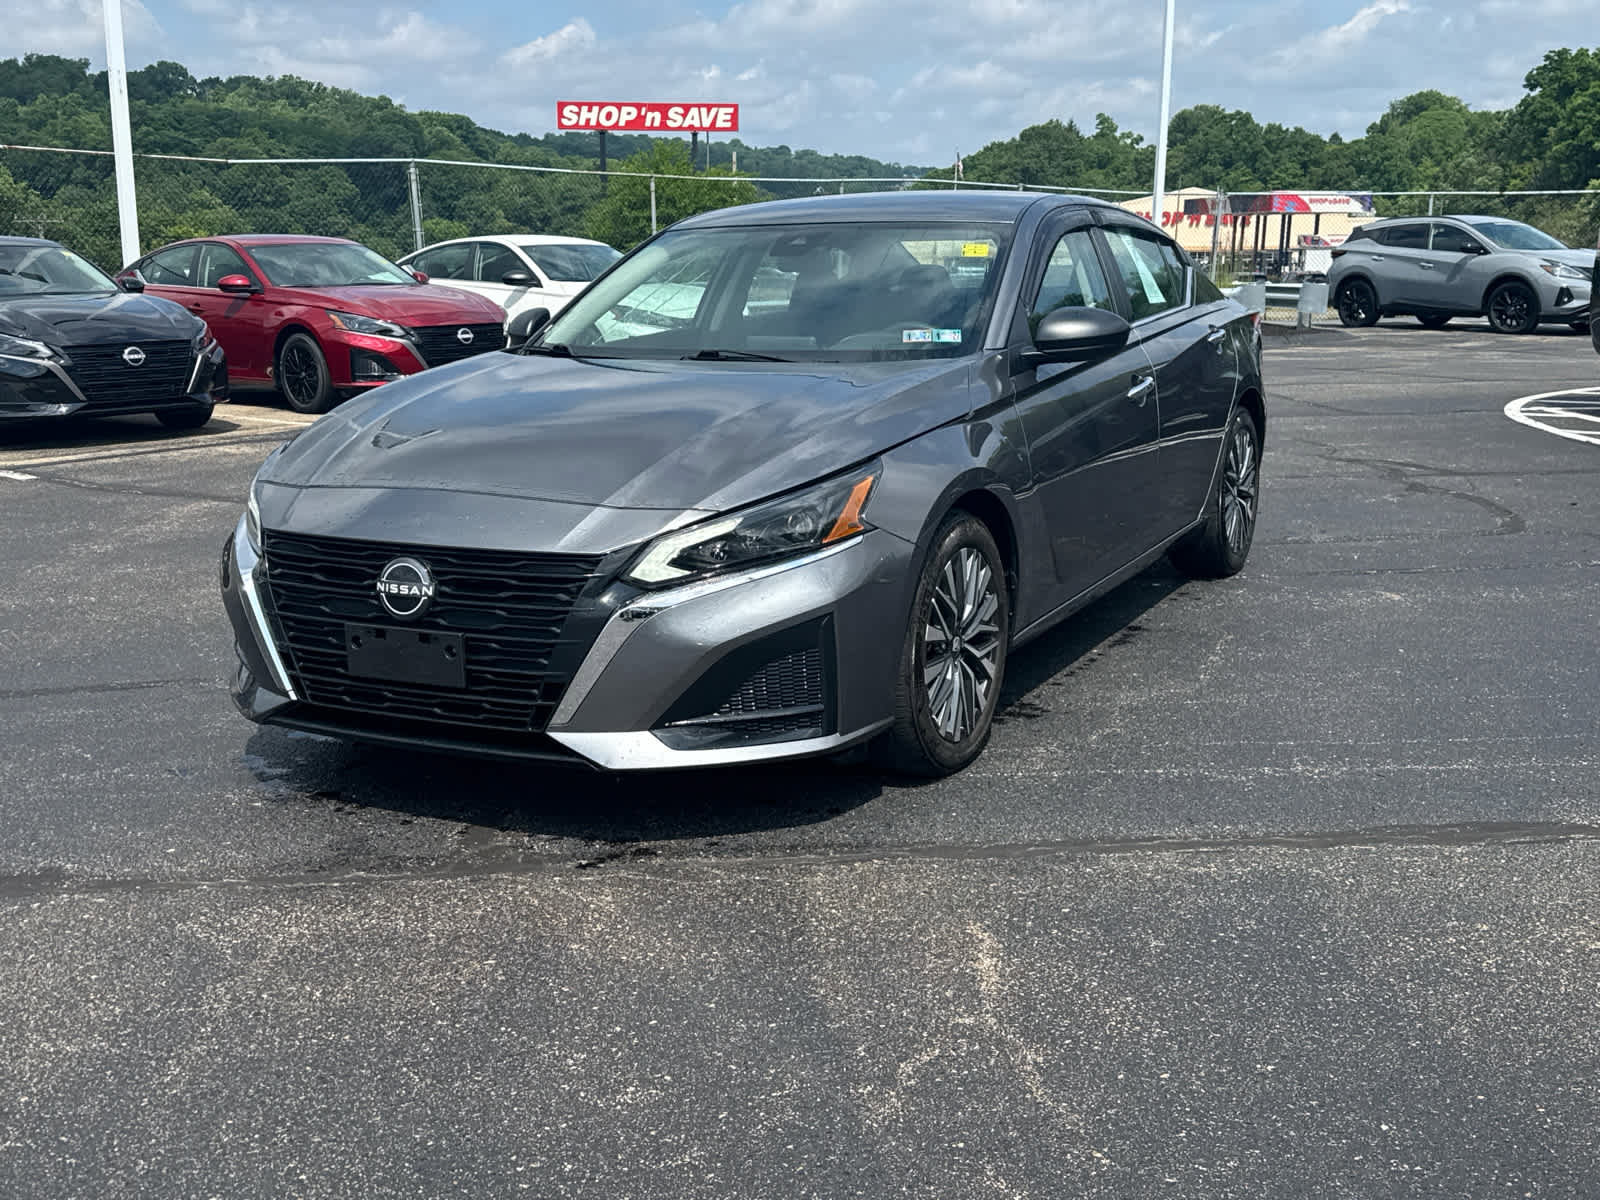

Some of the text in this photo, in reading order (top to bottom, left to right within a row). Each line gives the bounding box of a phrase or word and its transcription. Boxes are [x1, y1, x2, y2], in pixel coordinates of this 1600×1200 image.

[560, 104, 638, 127] SHOP
[666, 107, 735, 128] SAVE
[376, 582, 433, 596] NISSAN
